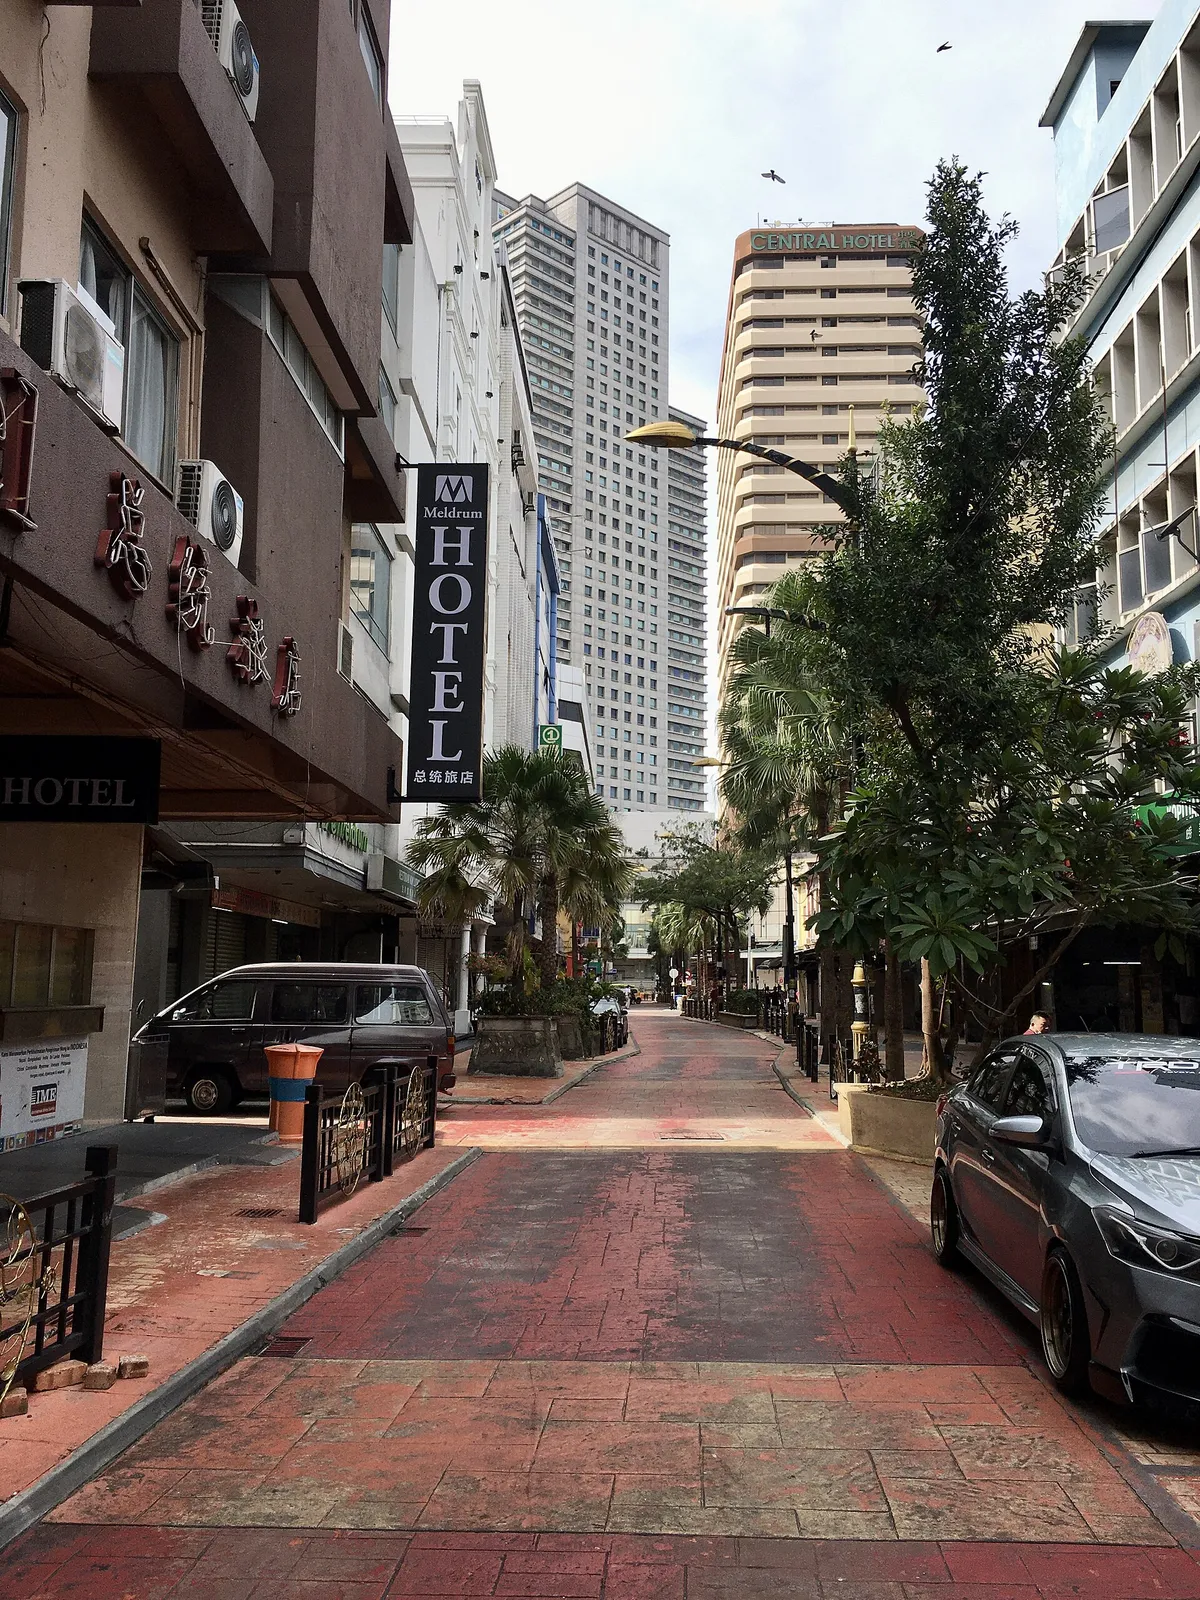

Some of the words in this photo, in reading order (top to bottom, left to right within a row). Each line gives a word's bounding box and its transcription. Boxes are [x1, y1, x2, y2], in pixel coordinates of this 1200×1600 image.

[750, 232, 840, 250] CENTRAL
[842, 233, 896, 249] HOTEL
[423, 506, 483, 520] Meldrum
[426, 526, 475, 762] HOTEL
[413, 769, 475, 785] 总统旅店
[1, 776, 136, 807] HOTEL
[1106, 1061, 1199, 1072] TRD
[36, 1087, 57, 1104] IME
